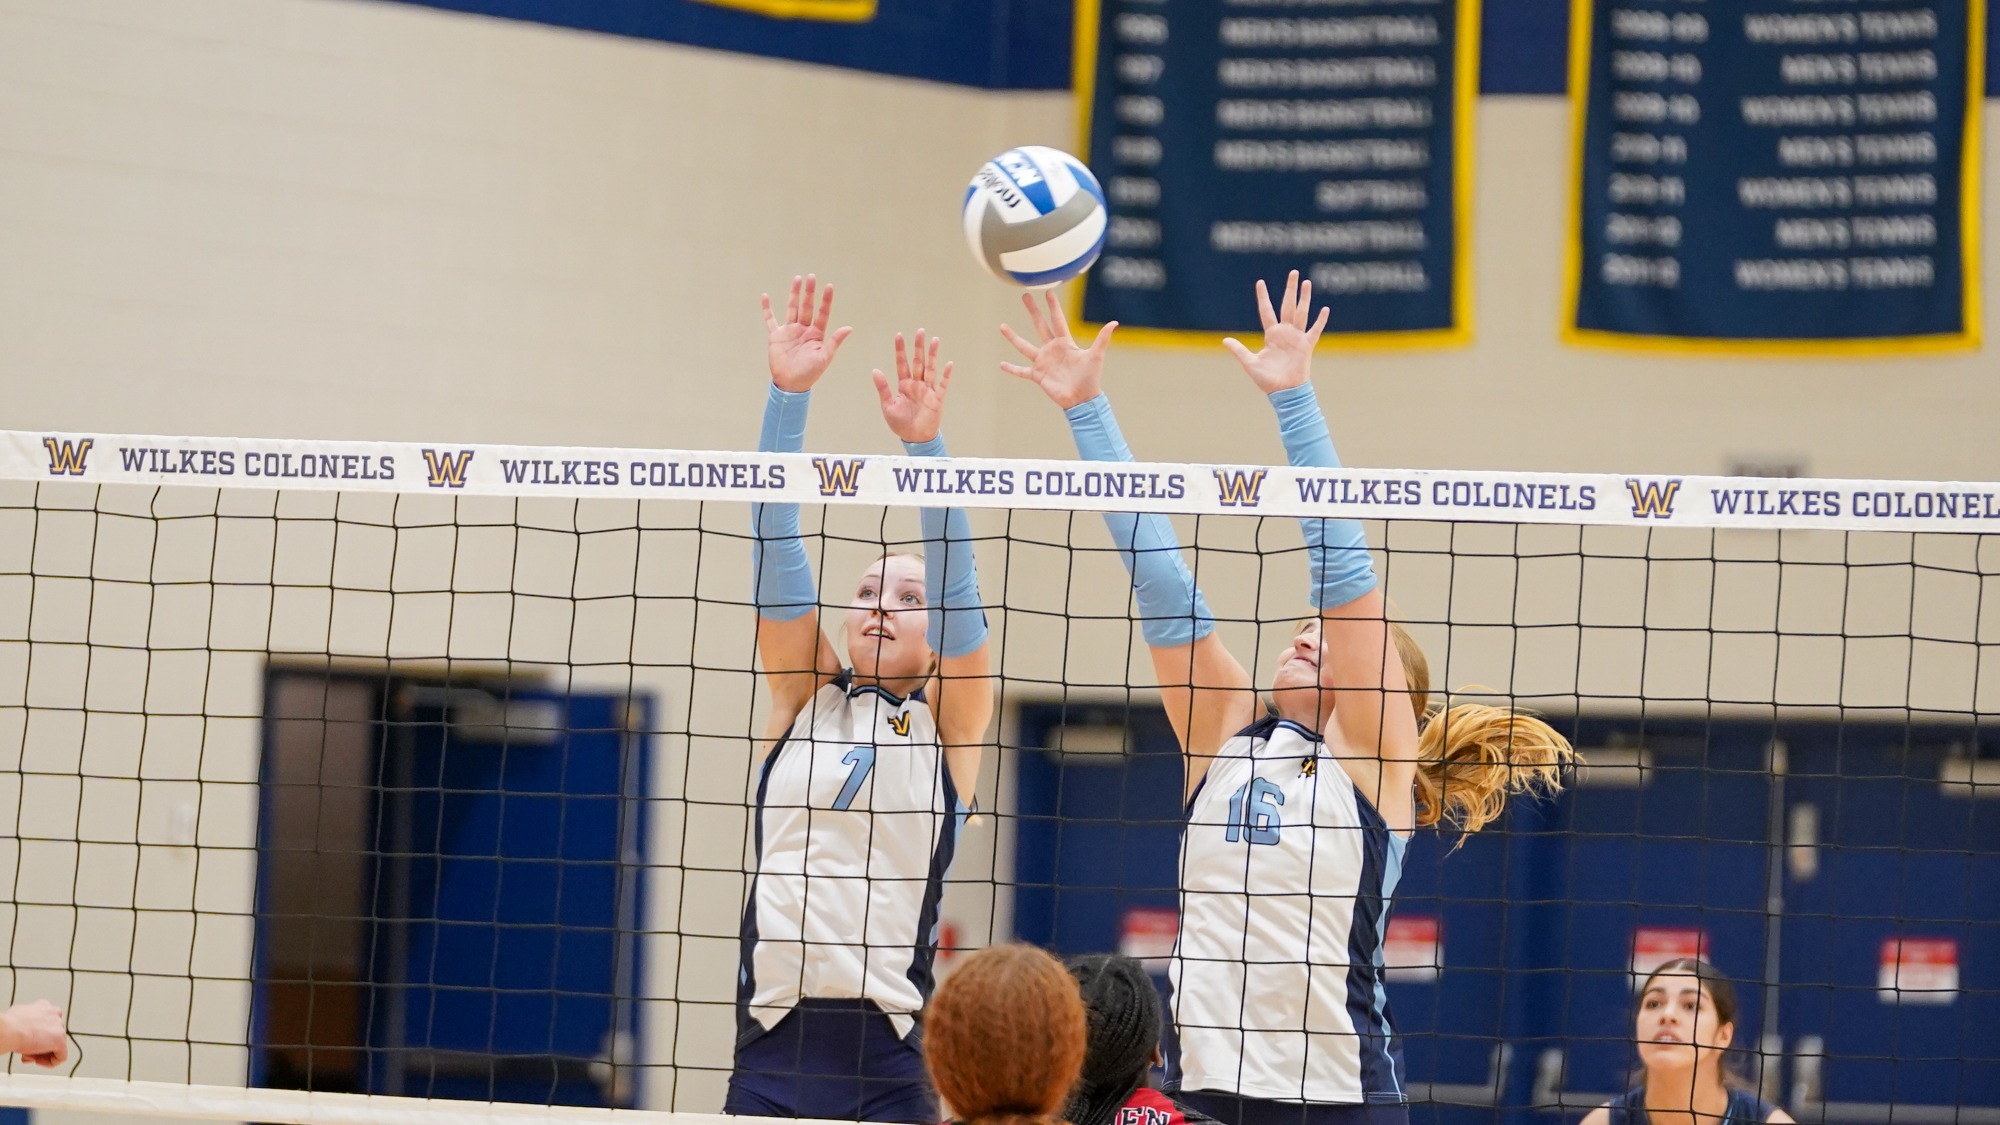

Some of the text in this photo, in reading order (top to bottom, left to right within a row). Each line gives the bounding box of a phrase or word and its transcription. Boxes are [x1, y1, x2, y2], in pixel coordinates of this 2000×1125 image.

[42, 436, 2000, 520] W WILKES COLONELS W WILKES COLONELS W WILKES COLONELS W WILKES COLONELS W WILKES COLONEL
[831, 745, 876, 811] 7
[1226, 777, 1284, 845] 16
